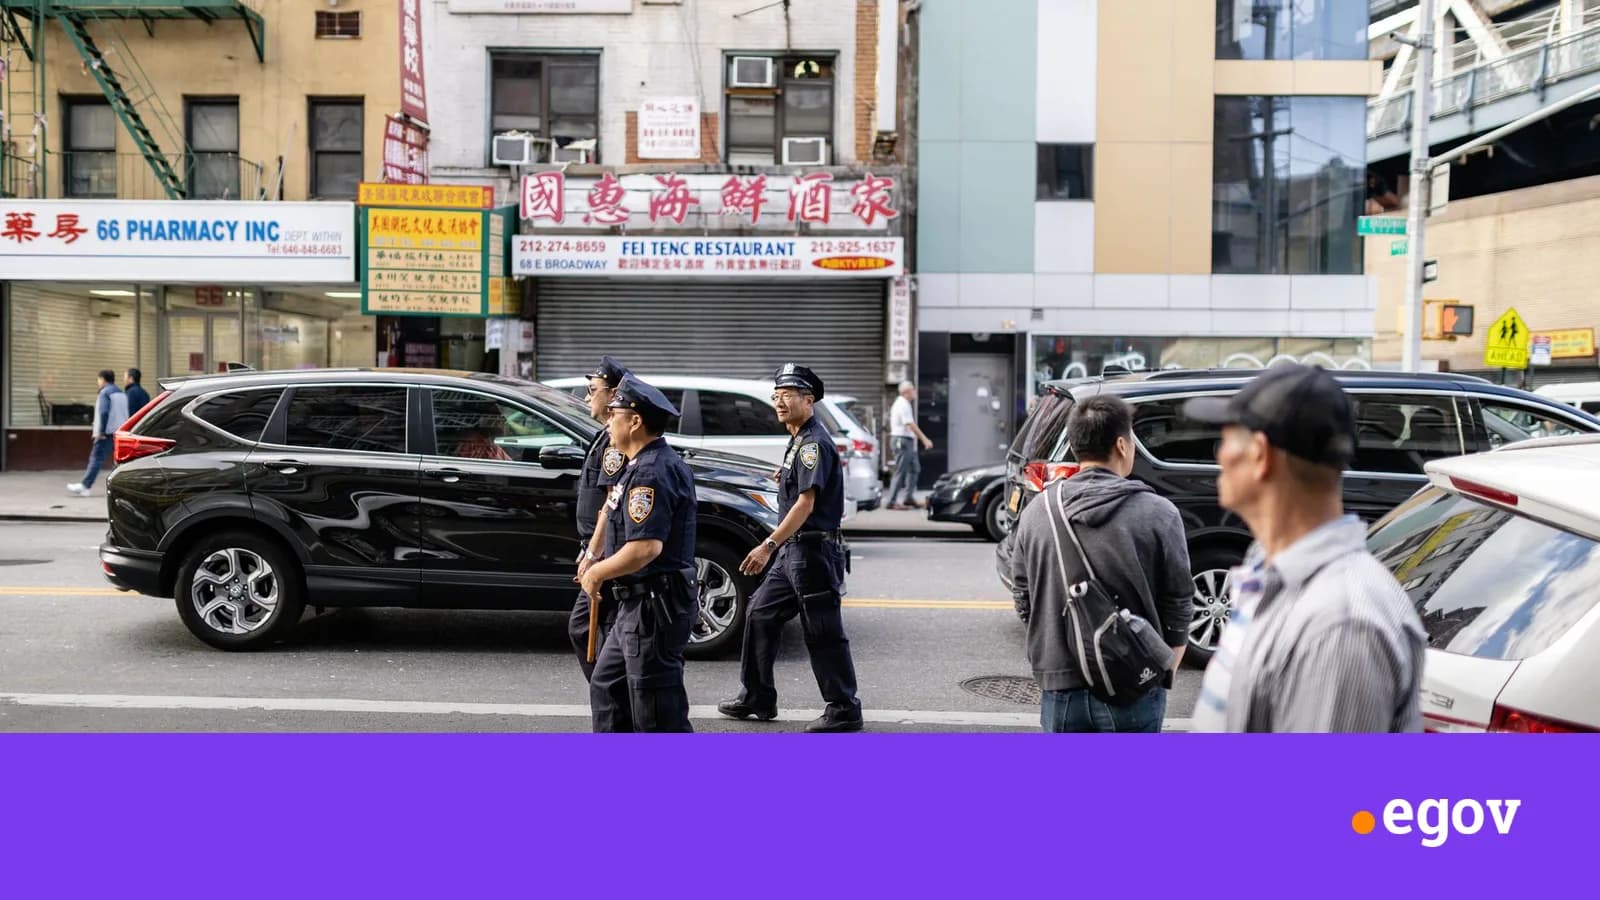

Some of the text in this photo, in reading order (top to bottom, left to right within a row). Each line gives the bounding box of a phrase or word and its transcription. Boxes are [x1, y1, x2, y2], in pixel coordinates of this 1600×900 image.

[520, 171, 898, 225] 國惠海鮮酒家
[97, 219, 280, 243] 66 PHARMACY INC
[311, 231, 342, 242] WITHIN
[520, 240, 607, 252] 212-274-8659
[621, 241, 645, 256] FEI
[694, 241, 796, 256] RESTAURANT
[810, 241, 896, 253] 212-925-1637
[520, 259, 607, 270] 68 E BROADWAY
[1490, 350, 1523, 363] AHEAD
